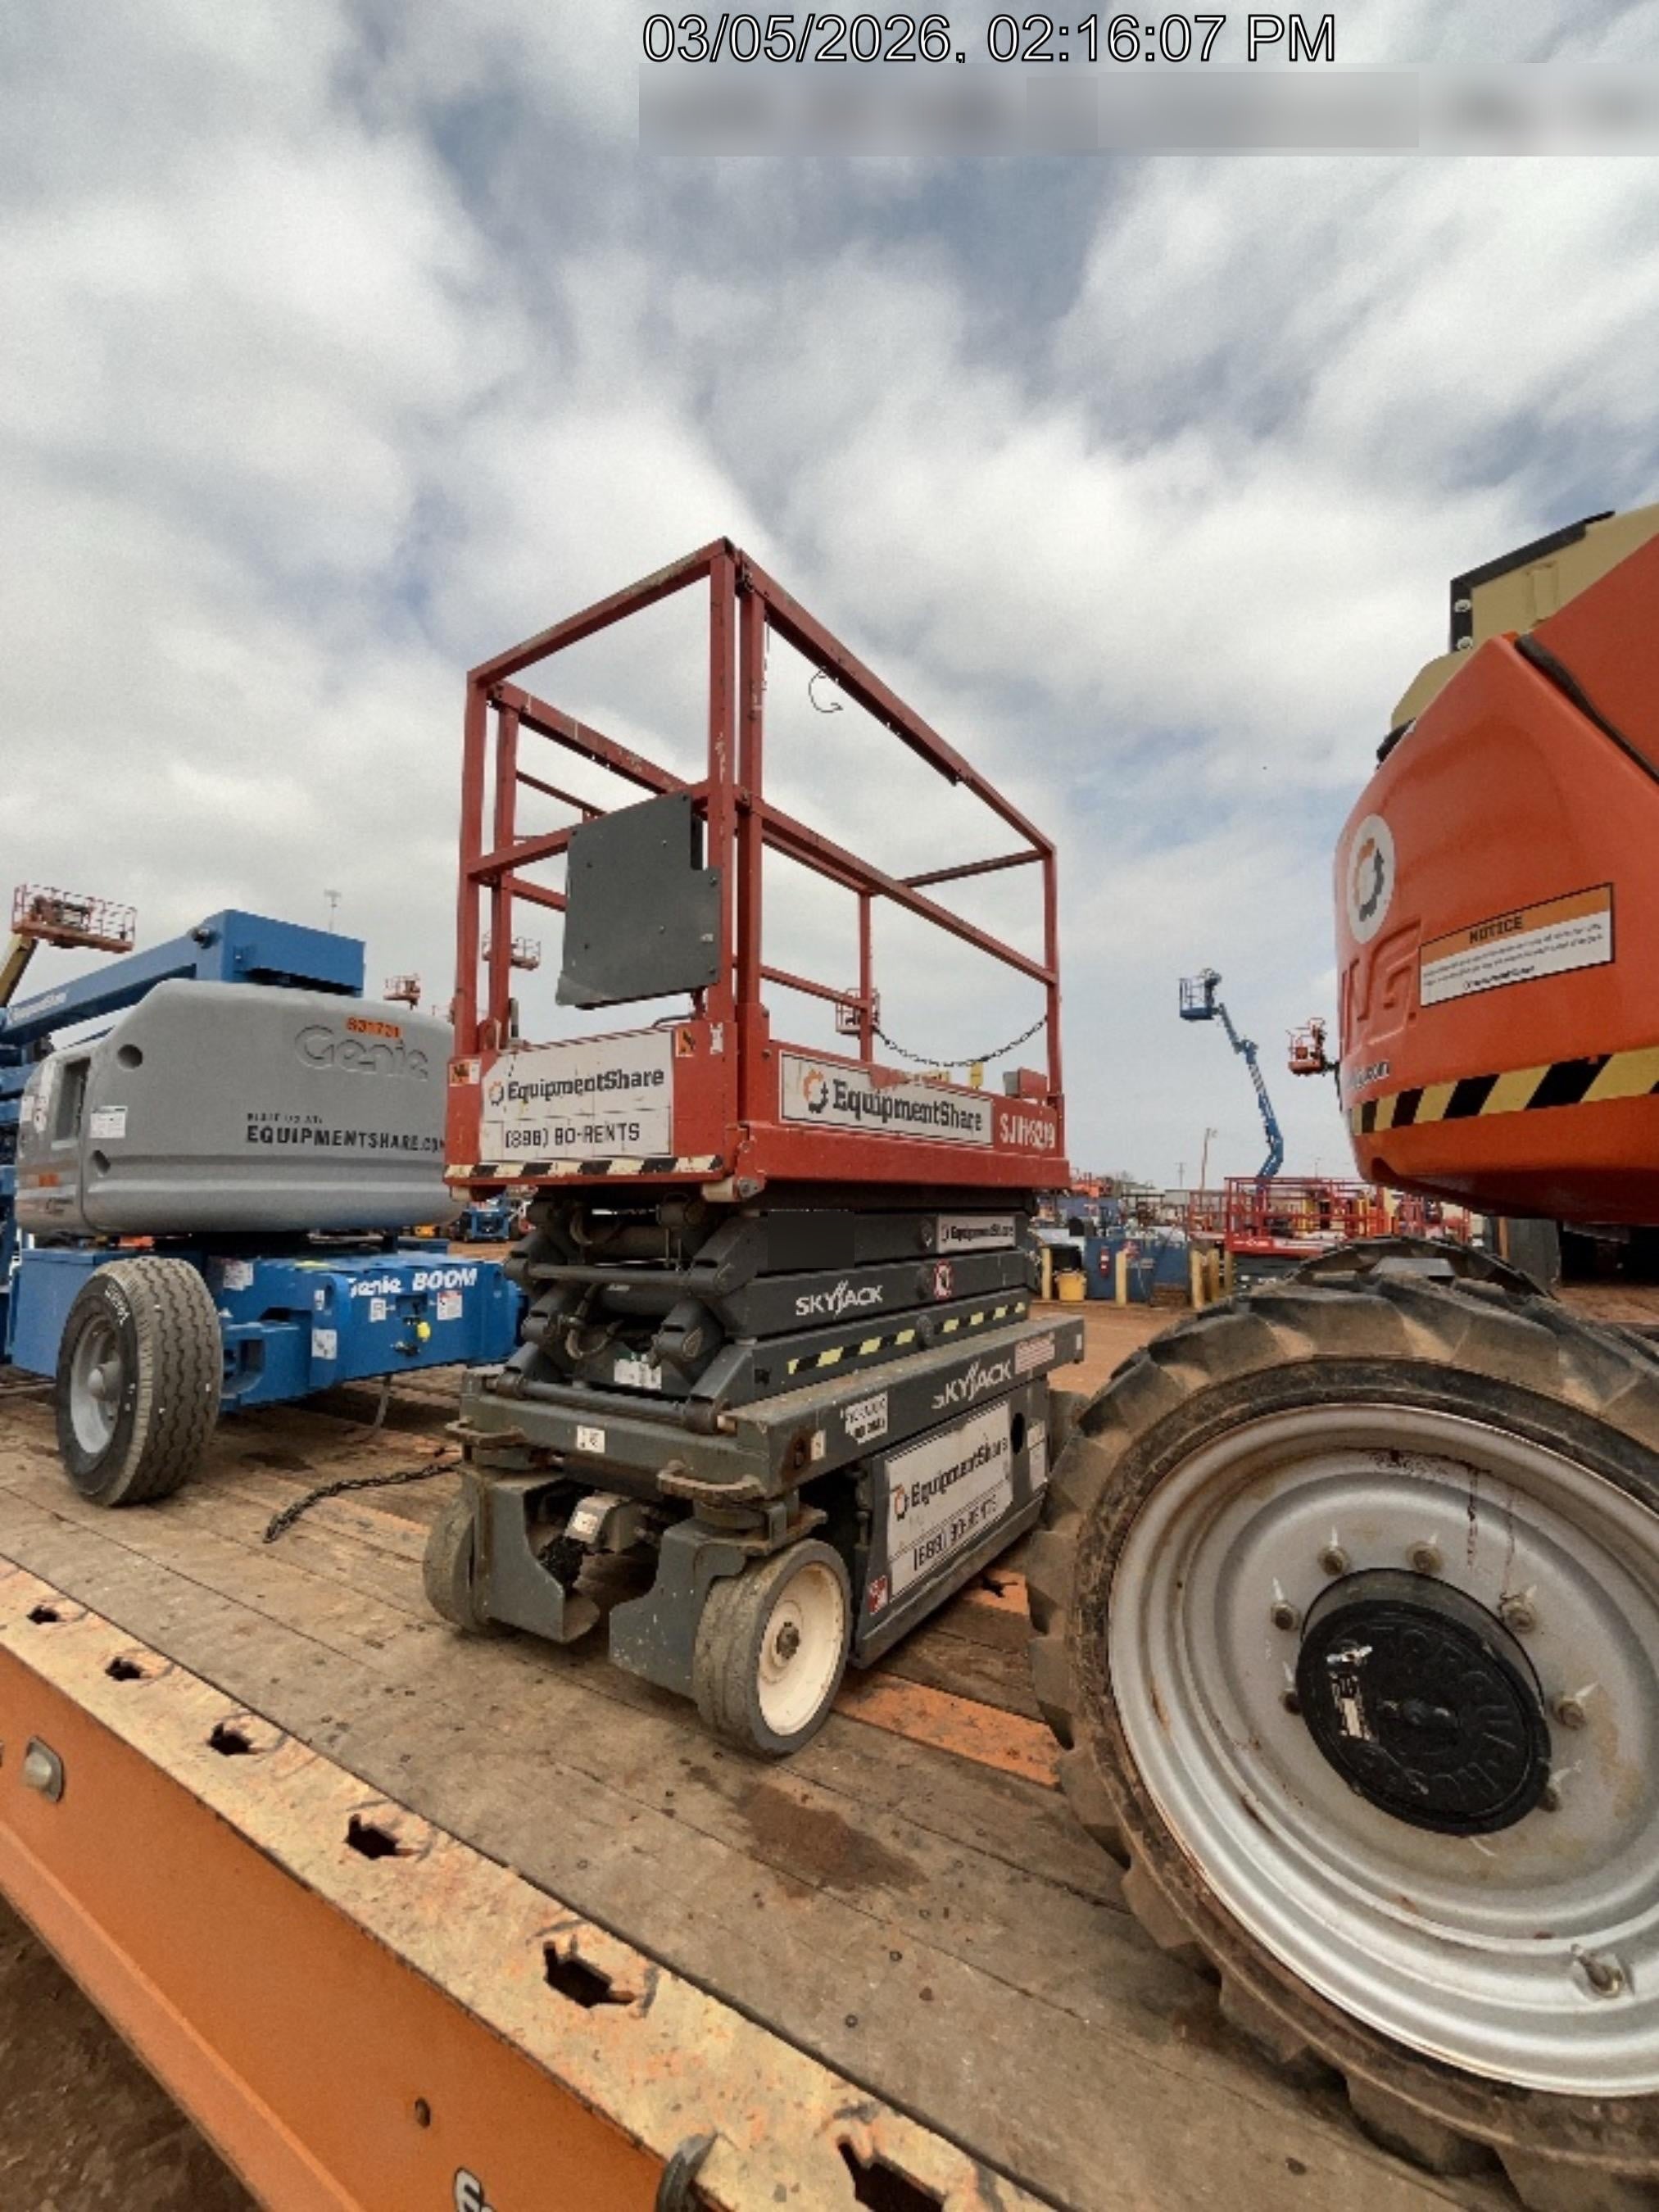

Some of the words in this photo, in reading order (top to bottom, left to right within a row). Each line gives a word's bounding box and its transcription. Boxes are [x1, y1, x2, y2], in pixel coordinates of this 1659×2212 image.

[1469, 916, 1523, 944] NOTICE
[295, 1025, 429, 1082] Genie
[507, 1068, 664, 1104] EquipmentShare
[832, 1077, 982, 1132] EquipmentShare
[412, 1268, 478, 1292] BOOM
[795, 1279, 883, 1321] SKYJACK
